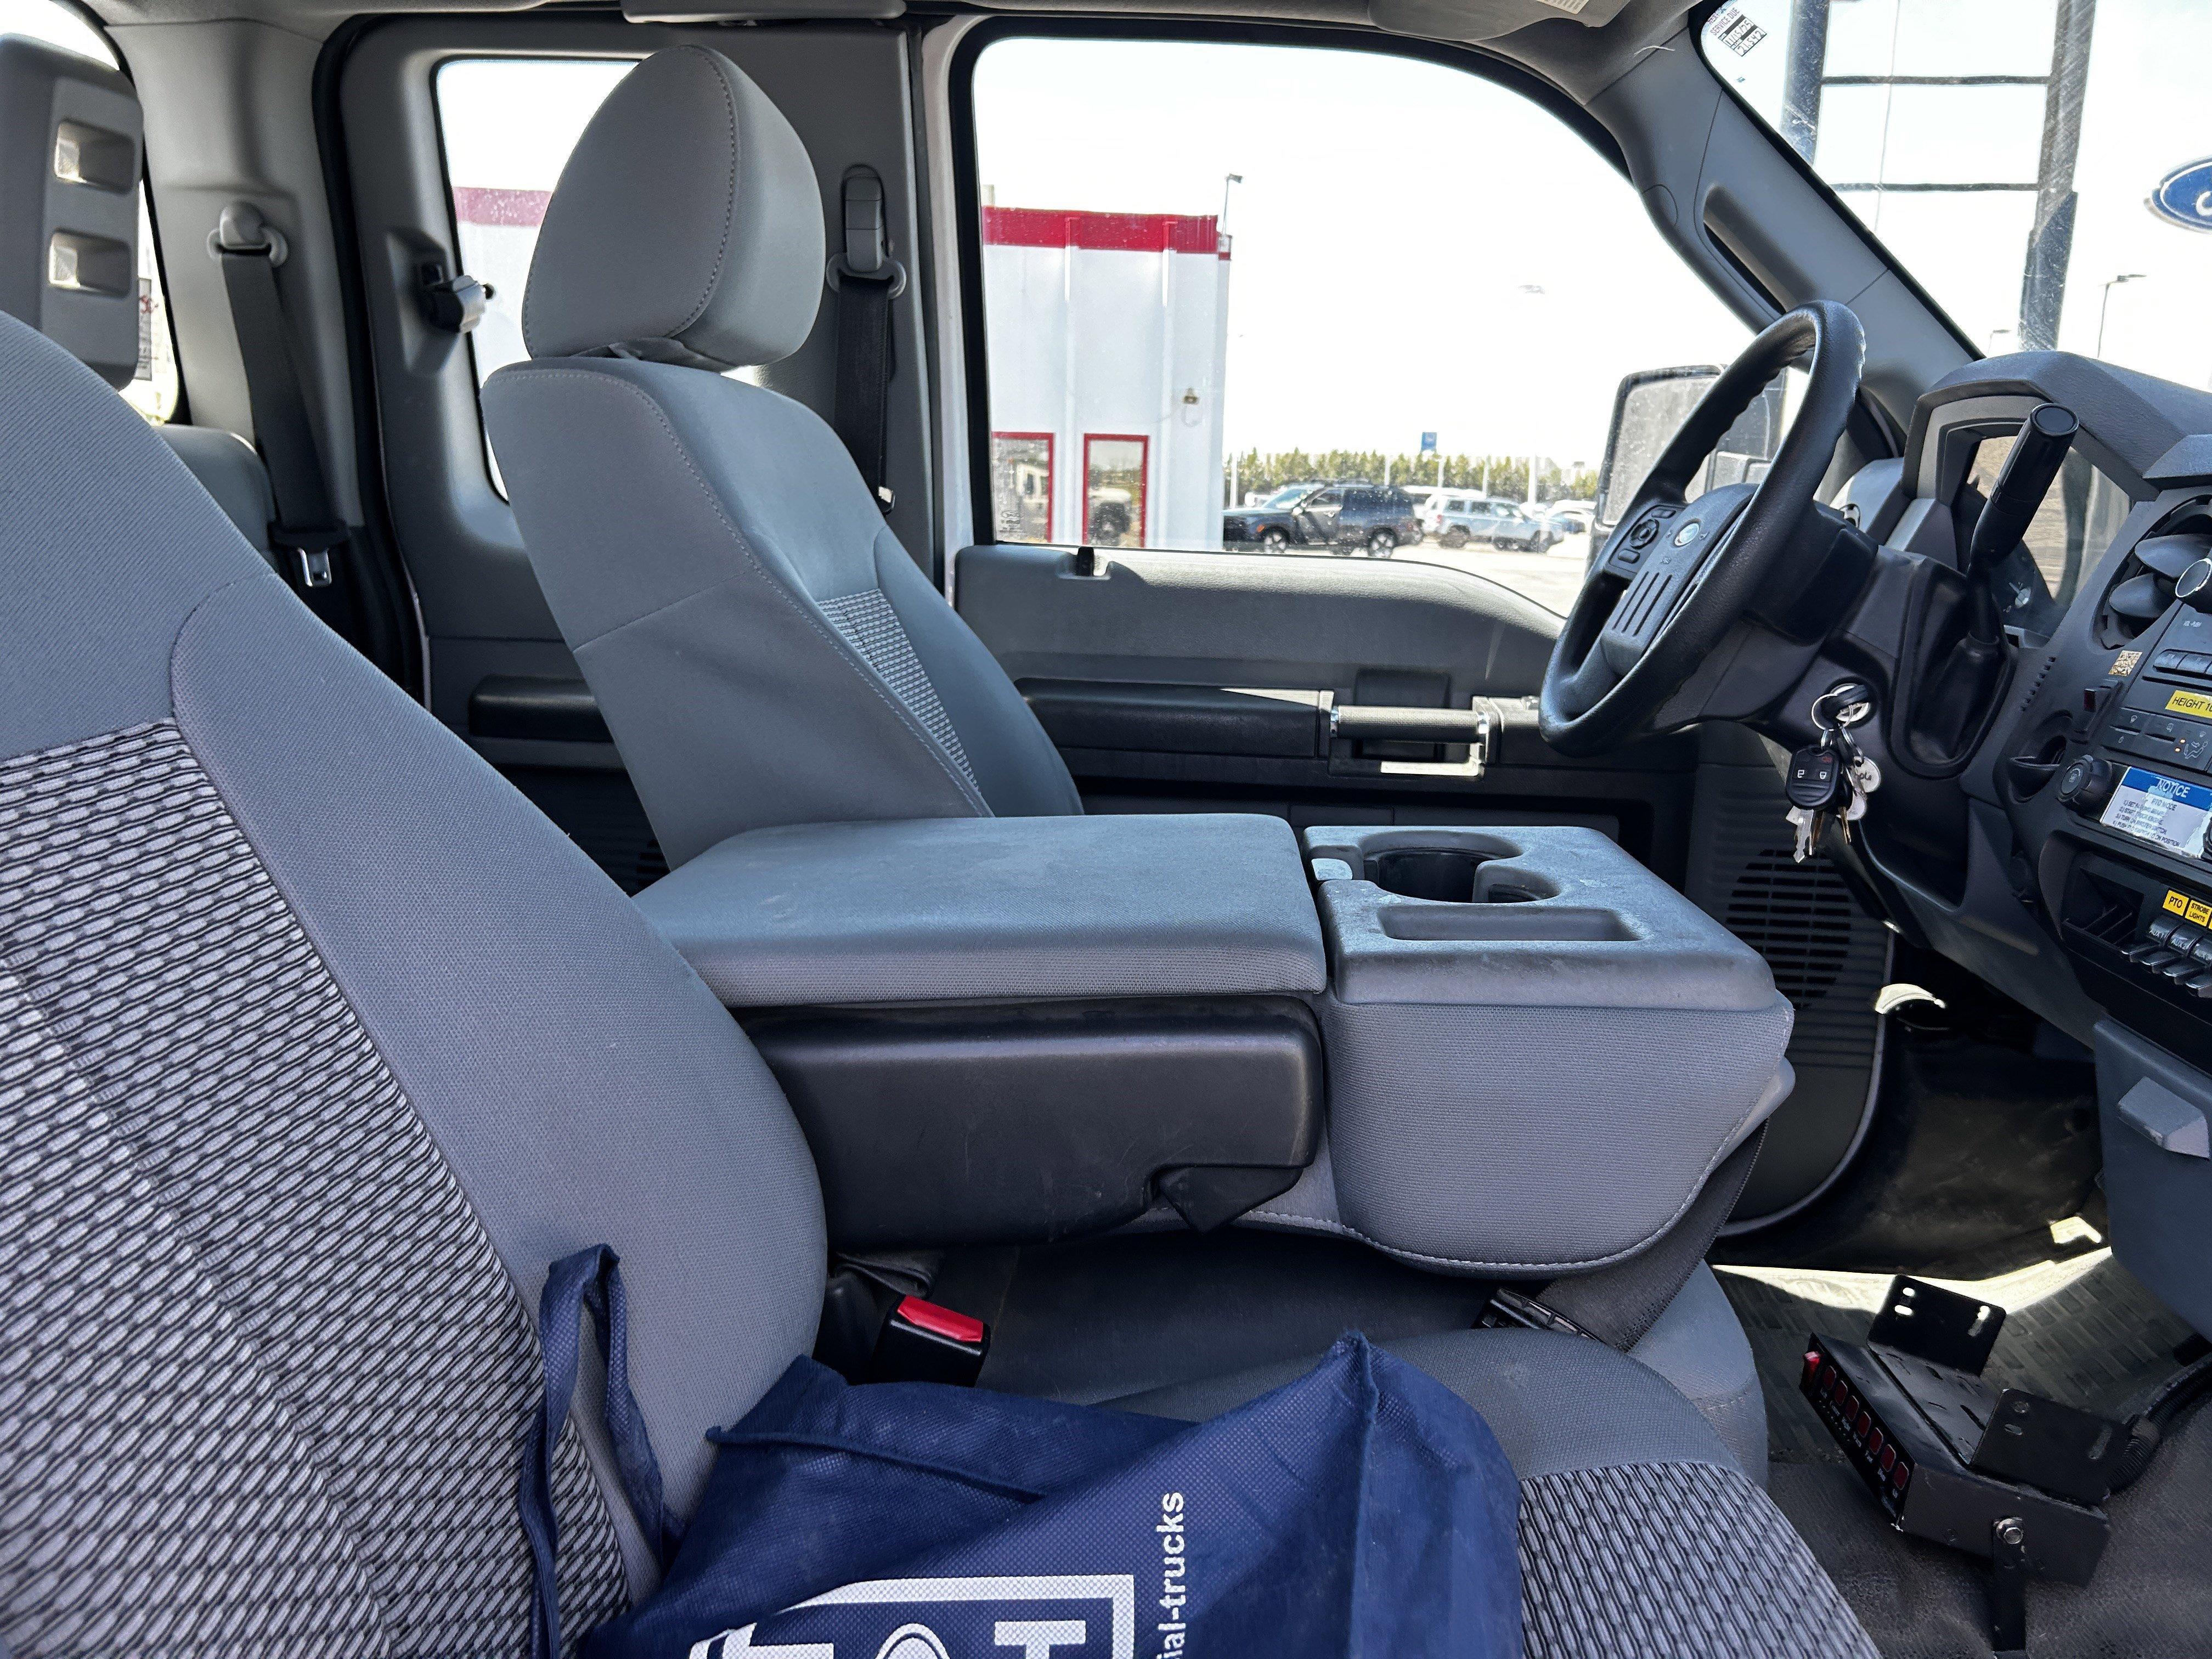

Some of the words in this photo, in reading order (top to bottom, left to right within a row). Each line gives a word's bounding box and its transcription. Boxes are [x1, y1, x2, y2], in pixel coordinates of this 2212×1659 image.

[1710, 16, 1730, 36] SERVICE
[1726, 7, 1740, 20] DUE
[2171, 696, 2205, 710] HEIGHT
[2157, 778, 2191, 798] NOTICE
[2162, 800, 2177, 811] MODE
[2162, 837, 2181, 847] POSITION
[2168, 896, 2183, 909] PTO
[2191, 902, 2210, 915] STROBE
[2189, 911, 2206, 923] LIGHTS
[1156, 1492, 1186, 1659] ial-trucks
